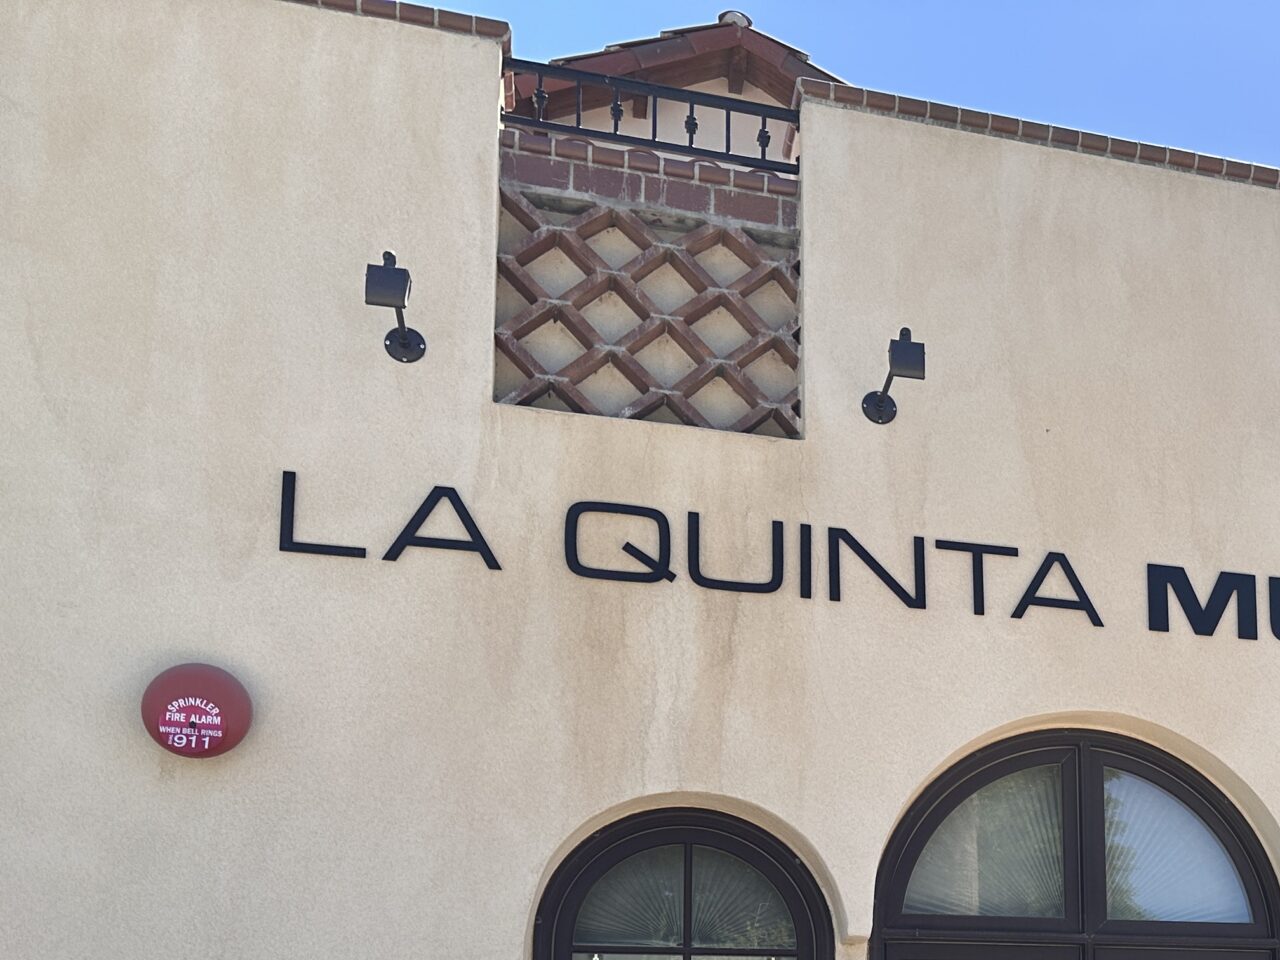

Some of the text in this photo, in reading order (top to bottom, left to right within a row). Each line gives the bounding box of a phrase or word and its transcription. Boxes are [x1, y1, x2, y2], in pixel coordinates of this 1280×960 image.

[278, 470, 503, 571] LA
[564, 501, 1105, 628] QUINTA
[167, 697, 220, 716] SPRINKLER
[165, 712, 221, 725] FIRE ALARM
[159, 726, 181, 734] WHEN
[201, 729, 222, 737] RINGS
[173, 734, 210, 749] 911
